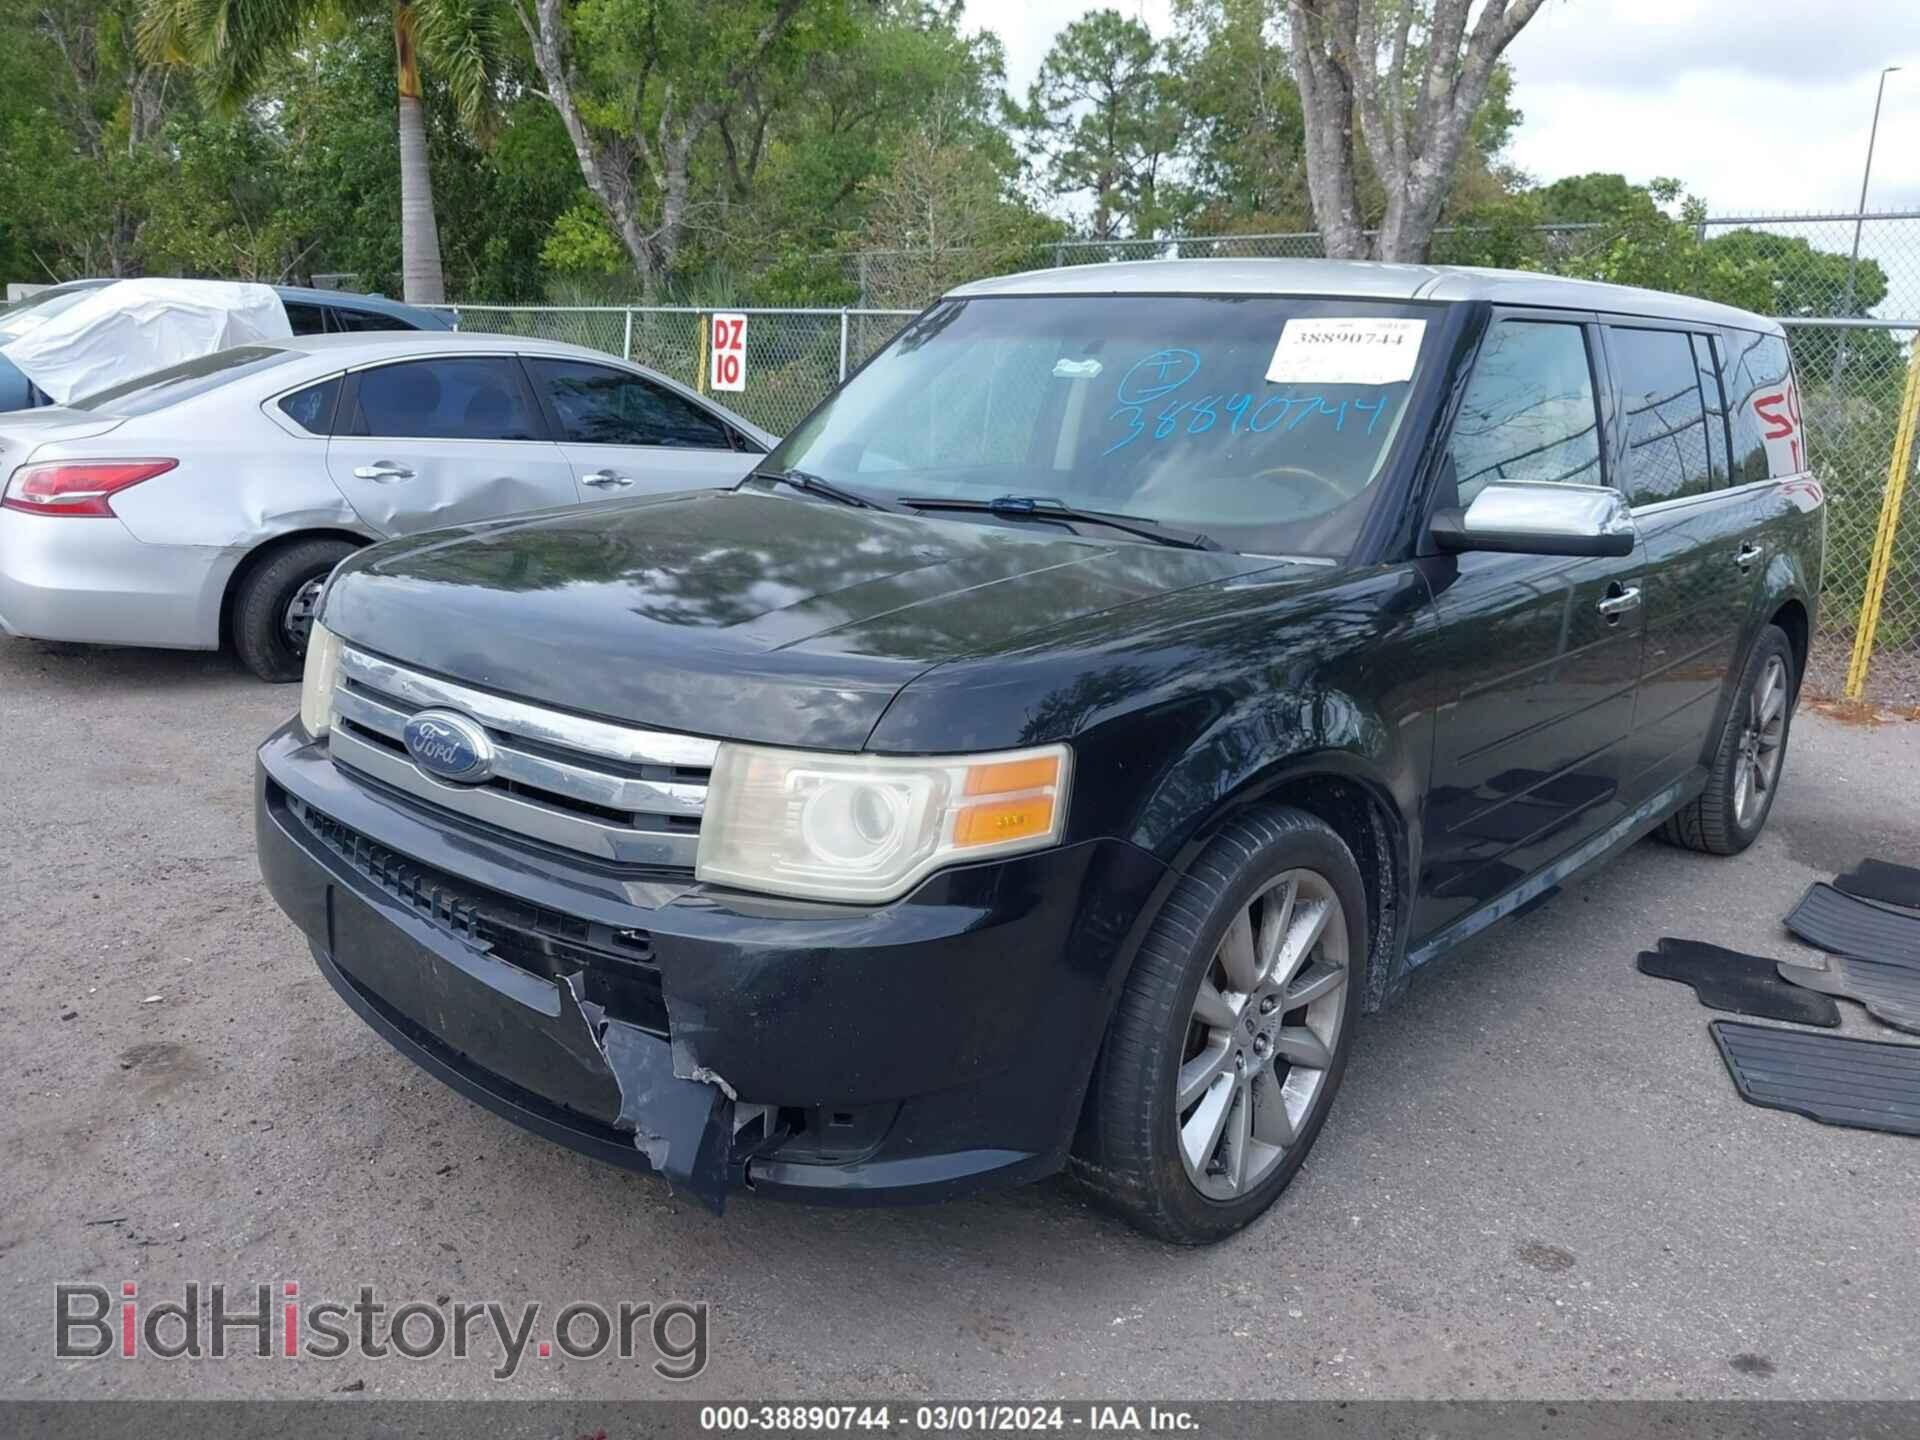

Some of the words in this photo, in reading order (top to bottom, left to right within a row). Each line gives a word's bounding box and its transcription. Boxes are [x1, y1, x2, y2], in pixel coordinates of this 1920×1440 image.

[715, 319, 743, 350] DZ
[1293, 331, 1404, 345] 38890744
[717, 354, 739, 384] 10
[1102, 393, 1388, 456] 38890744
[413, 722, 460, 764] Ford
